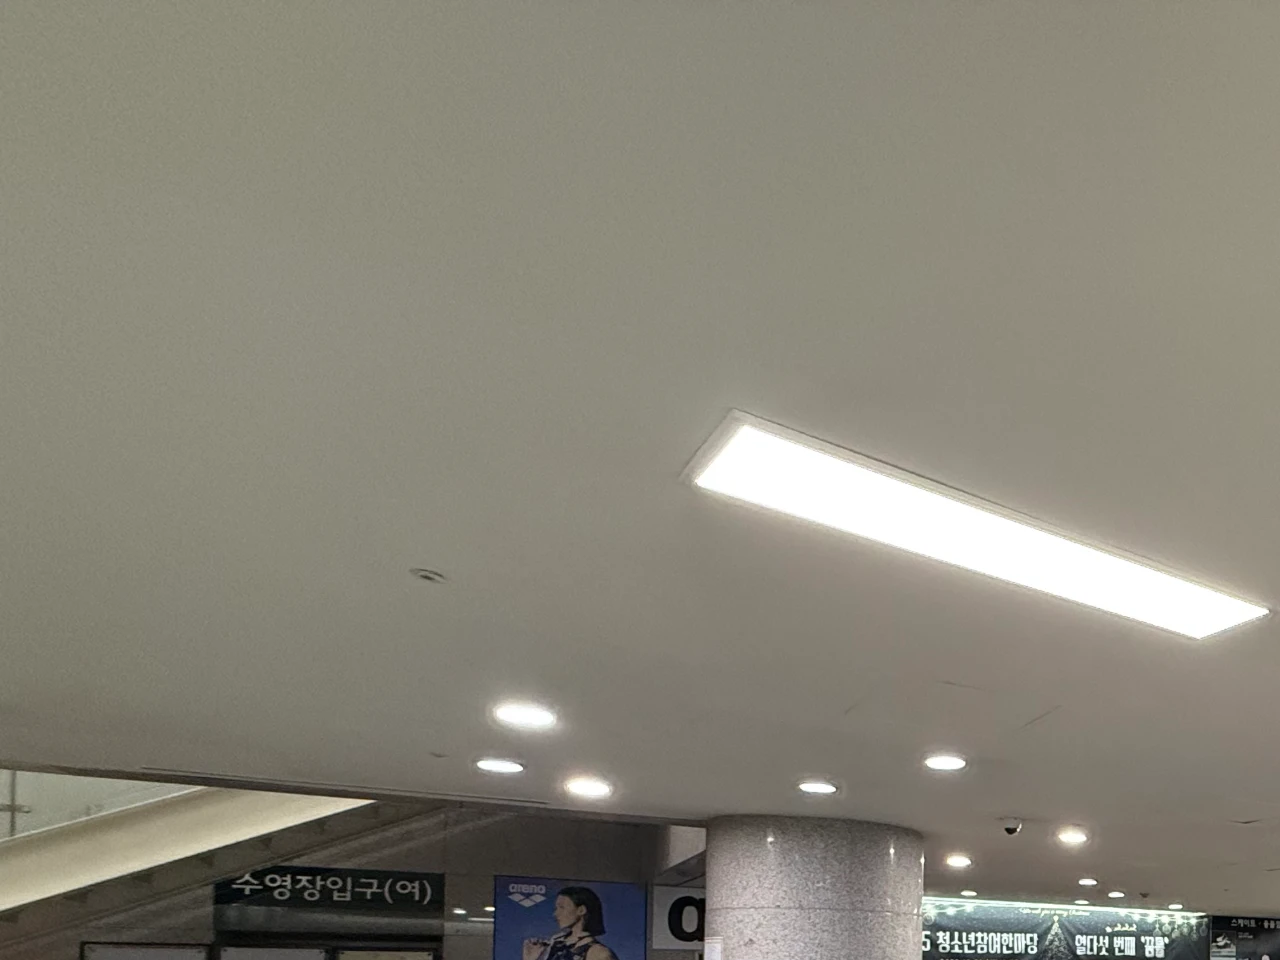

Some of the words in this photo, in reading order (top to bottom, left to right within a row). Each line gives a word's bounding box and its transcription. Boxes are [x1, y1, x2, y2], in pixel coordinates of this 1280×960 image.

[231, 873, 432, 905] 수영장입구(여)
[508, 883, 546, 894] arena
[936, 931, 1039, 954] 청소년참여한마당
[1075, 934, 1109, 956] 열다섯
[1113, 936, 1136, 956] 번째
